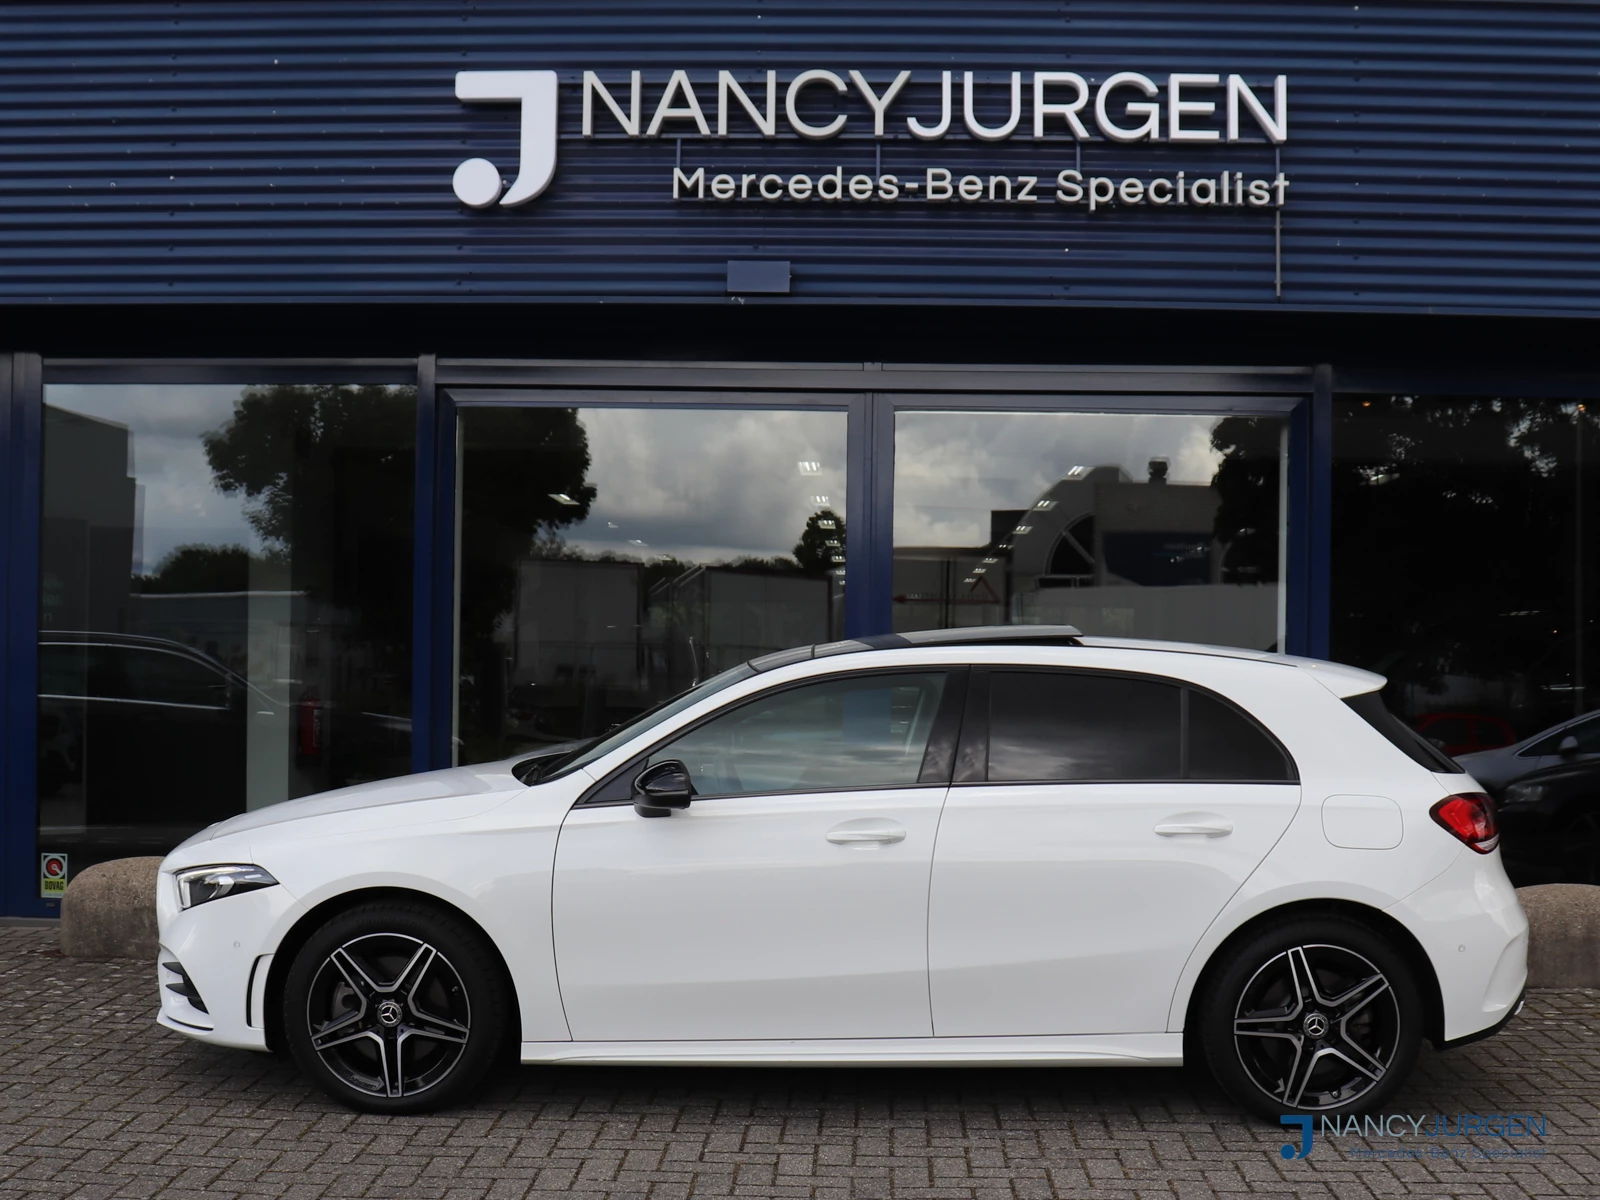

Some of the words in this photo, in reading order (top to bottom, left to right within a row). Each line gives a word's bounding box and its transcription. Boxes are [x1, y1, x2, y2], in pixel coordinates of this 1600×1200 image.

[581, 69, 1288, 143] NANCYJURGEN
[672, 166, 1038, 203] Mercedes-Benz
[1056, 169, 1290, 212] Specialist
[44, 880, 64, 891] BOVAG
